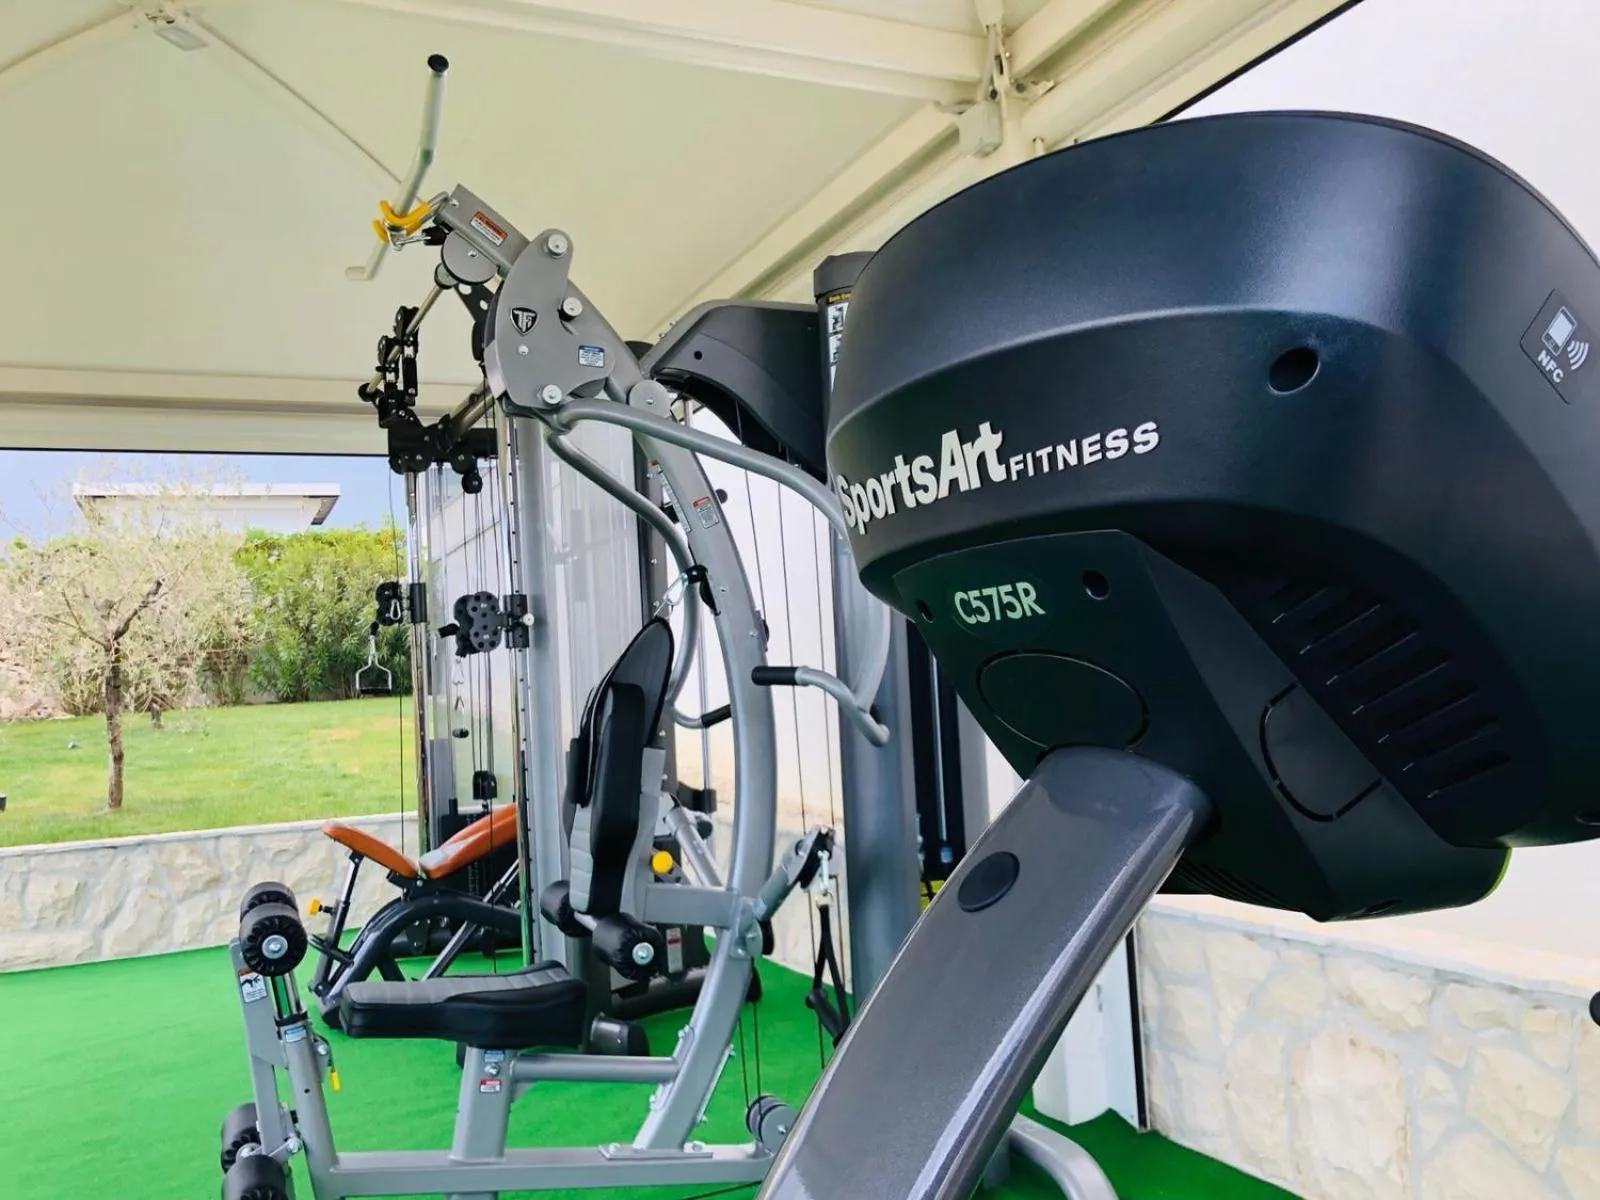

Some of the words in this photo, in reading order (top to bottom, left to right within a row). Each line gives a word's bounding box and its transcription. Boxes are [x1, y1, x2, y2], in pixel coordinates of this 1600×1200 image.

[1537, 350, 1564, 383] NFC
[838, 421, 1007, 535] SportsArt
[1009, 421, 1160, 482] FITNESS
[954, 581, 1046, 625] C575R
